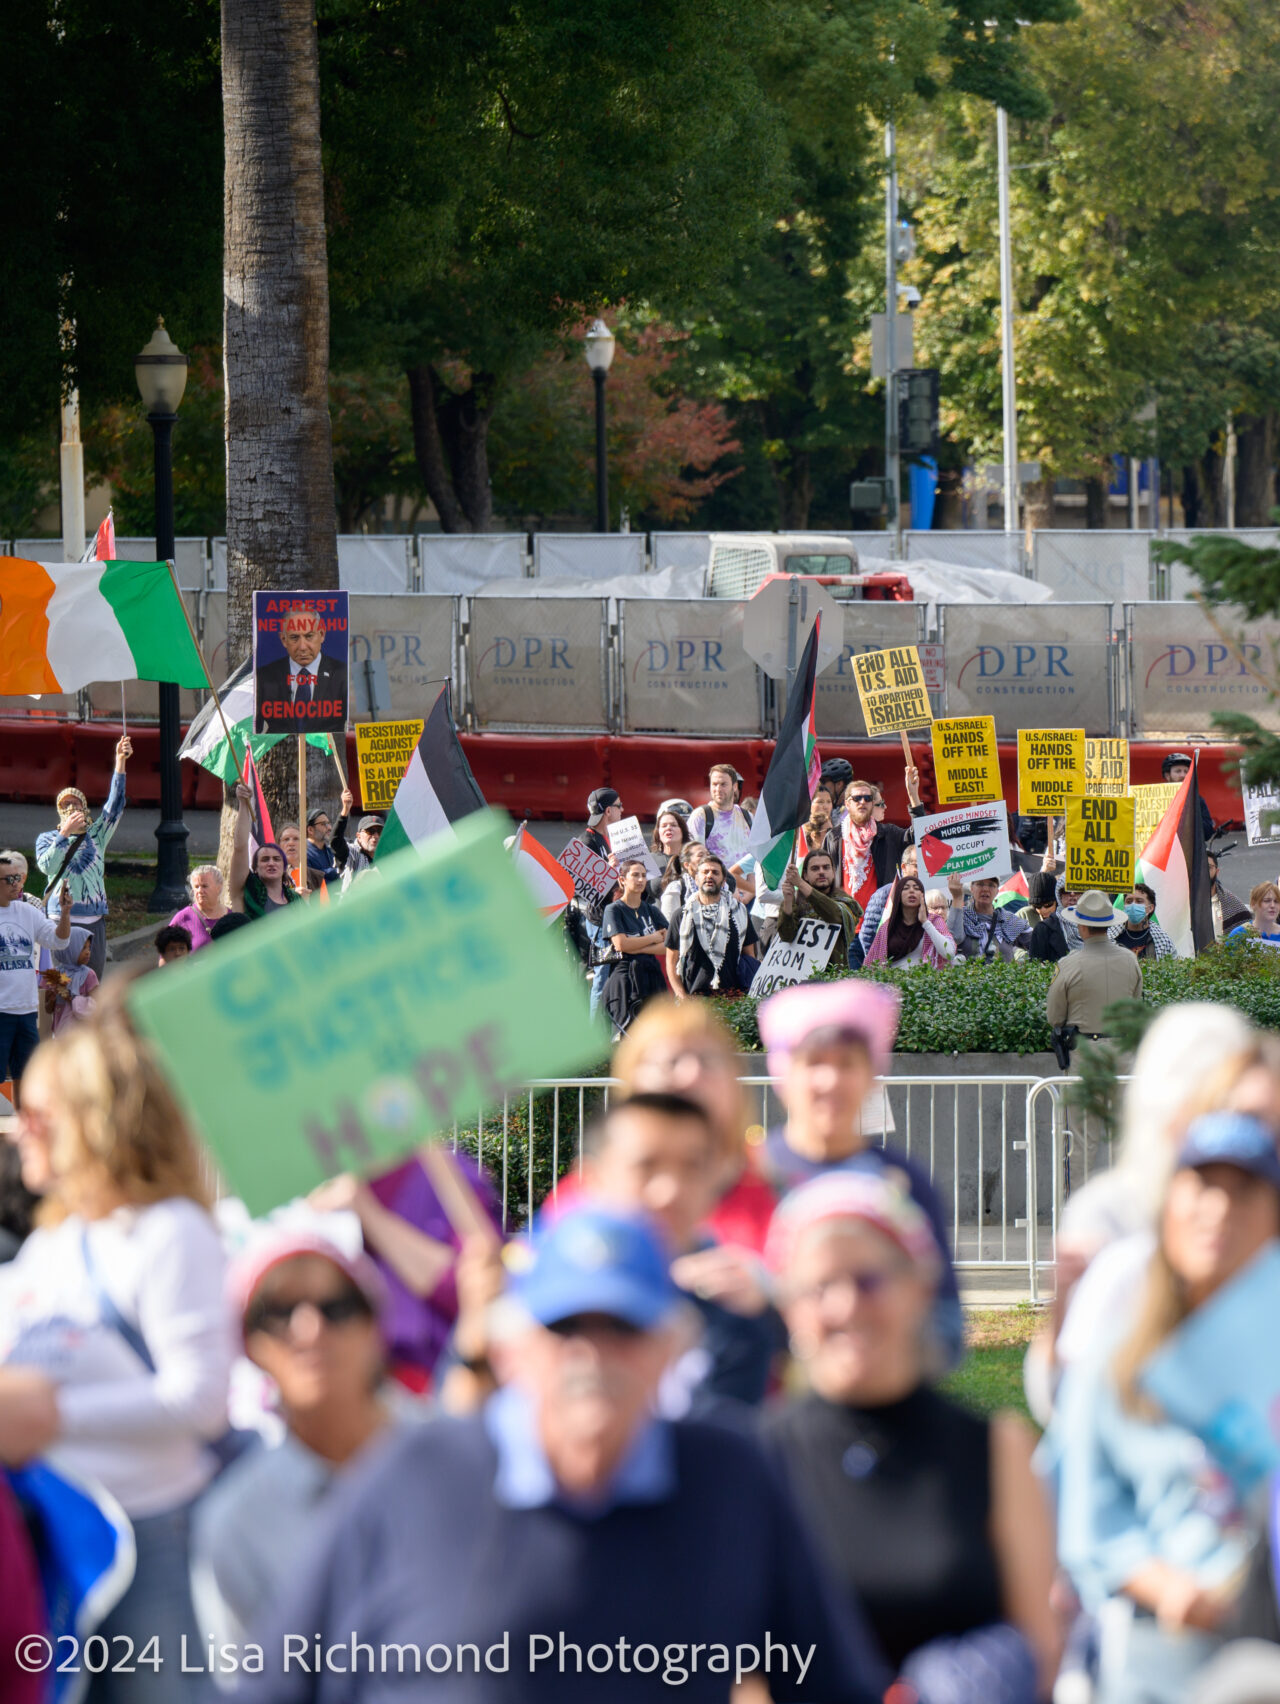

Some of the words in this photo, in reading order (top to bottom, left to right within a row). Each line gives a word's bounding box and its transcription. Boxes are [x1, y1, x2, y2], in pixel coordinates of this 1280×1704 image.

[266, 599, 338, 612] ARREST
[257, 618, 348, 632] NETANYAHU
[493, 636, 574, 669] DPR
[647, 639, 727, 672] DPR
[856, 653, 886, 674] END
[889, 648, 917, 669] ALL
[976, 645, 1074, 677] DPR
[1166, 644, 1268, 677] DPR
[287, 674, 318, 685] FOR
[647, 680, 728, 689] CONSTRUCTION
[860, 672, 891, 693] U.S.
[894, 667, 919, 687] AID
[976, 686, 1075, 695] CONSTRUCTION
[865, 697, 877, 708] TO
[878, 688, 924, 704] APARTHEID
[261, 700, 343, 718] GENOCIDE
[870, 700, 926, 725] ISRAEL!
[906, 719, 931, 728] Coalition
[938, 720, 987, 731] U.S./ISRAEL:
[359, 724, 421, 738] RESISTANCE
[944, 731, 984, 745] HANDS
[1025, 733, 1078, 742] U.S./ISRAEL:
[370, 737, 413, 751] AGAINST
[1030, 744, 1073, 756] HANDS
[1100, 741, 1124, 759] ALL
[361, 751, 413, 764] OCCUPATI
[942, 747, 964, 759] OFF
[967, 745, 989, 757] THE
[1027, 758, 1050, 770] OFF
[1054, 757, 1076, 769] THE
[1101, 760, 1123, 779] AID
[365, 769, 376, 780] IS
[377, 767, 385, 779] A
[948, 767, 988, 781] MIDDLE
[366, 779, 400, 801] RIG
[954, 781, 985, 794] EAST!
[1031, 781, 1073, 793] MIDDLE
[1085, 783, 1124, 794] PARTHEID
[1133, 787, 1160, 797] STAND
[1165, 785, 1180, 796] WIT
[1036, 794, 1065, 807] EAST
[1081, 799, 1117, 820] END
[924, 813, 963, 833] COLONIZER
[966, 809, 998, 819] MINDSET
[940, 824, 971, 839] MURDER
[1083, 821, 1115, 842] ALL
[956, 839, 985, 851] OCCUPY
[569, 840, 619, 880] STOP
[946, 858, 965, 870] PLAY
[966, 852, 991, 867] VICTIM
[1070, 847, 1099, 866] U.S.
[1103, 850, 1129, 868] AID
[559, 848, 607, 893] KILLING
[1069, 867, 1082, 881] TO
[1085, 868, 1130, 883] ISRAEL!
[0, 960, 33, 971] ALASKA
[768, 949, 805, 971] FROM
